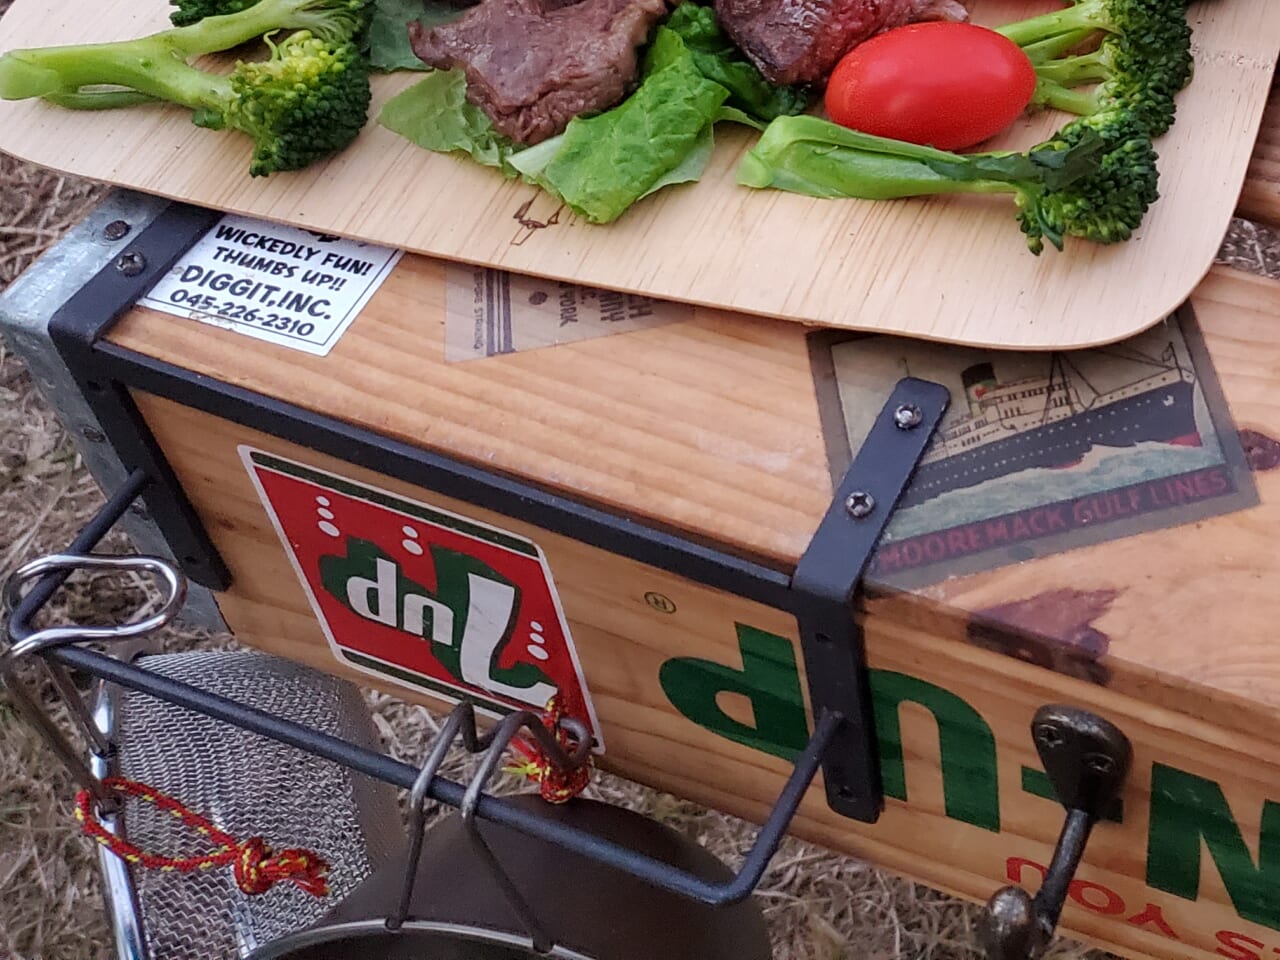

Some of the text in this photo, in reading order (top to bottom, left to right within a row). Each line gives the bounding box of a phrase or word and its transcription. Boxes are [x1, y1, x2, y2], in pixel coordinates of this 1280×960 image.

[212, 246, 348, 292] THUMBS UP!!
[214, 224, 375, 277] WICKEDLY FUN!
[169, 288, 316, 337] 045-226-2310
[179, 265, 332, 320] DIGGIT,INC.
[879, 469, 1228, 570] MOOREMACK GULF LINES
[1005, 856, 1181, 940] YOU
